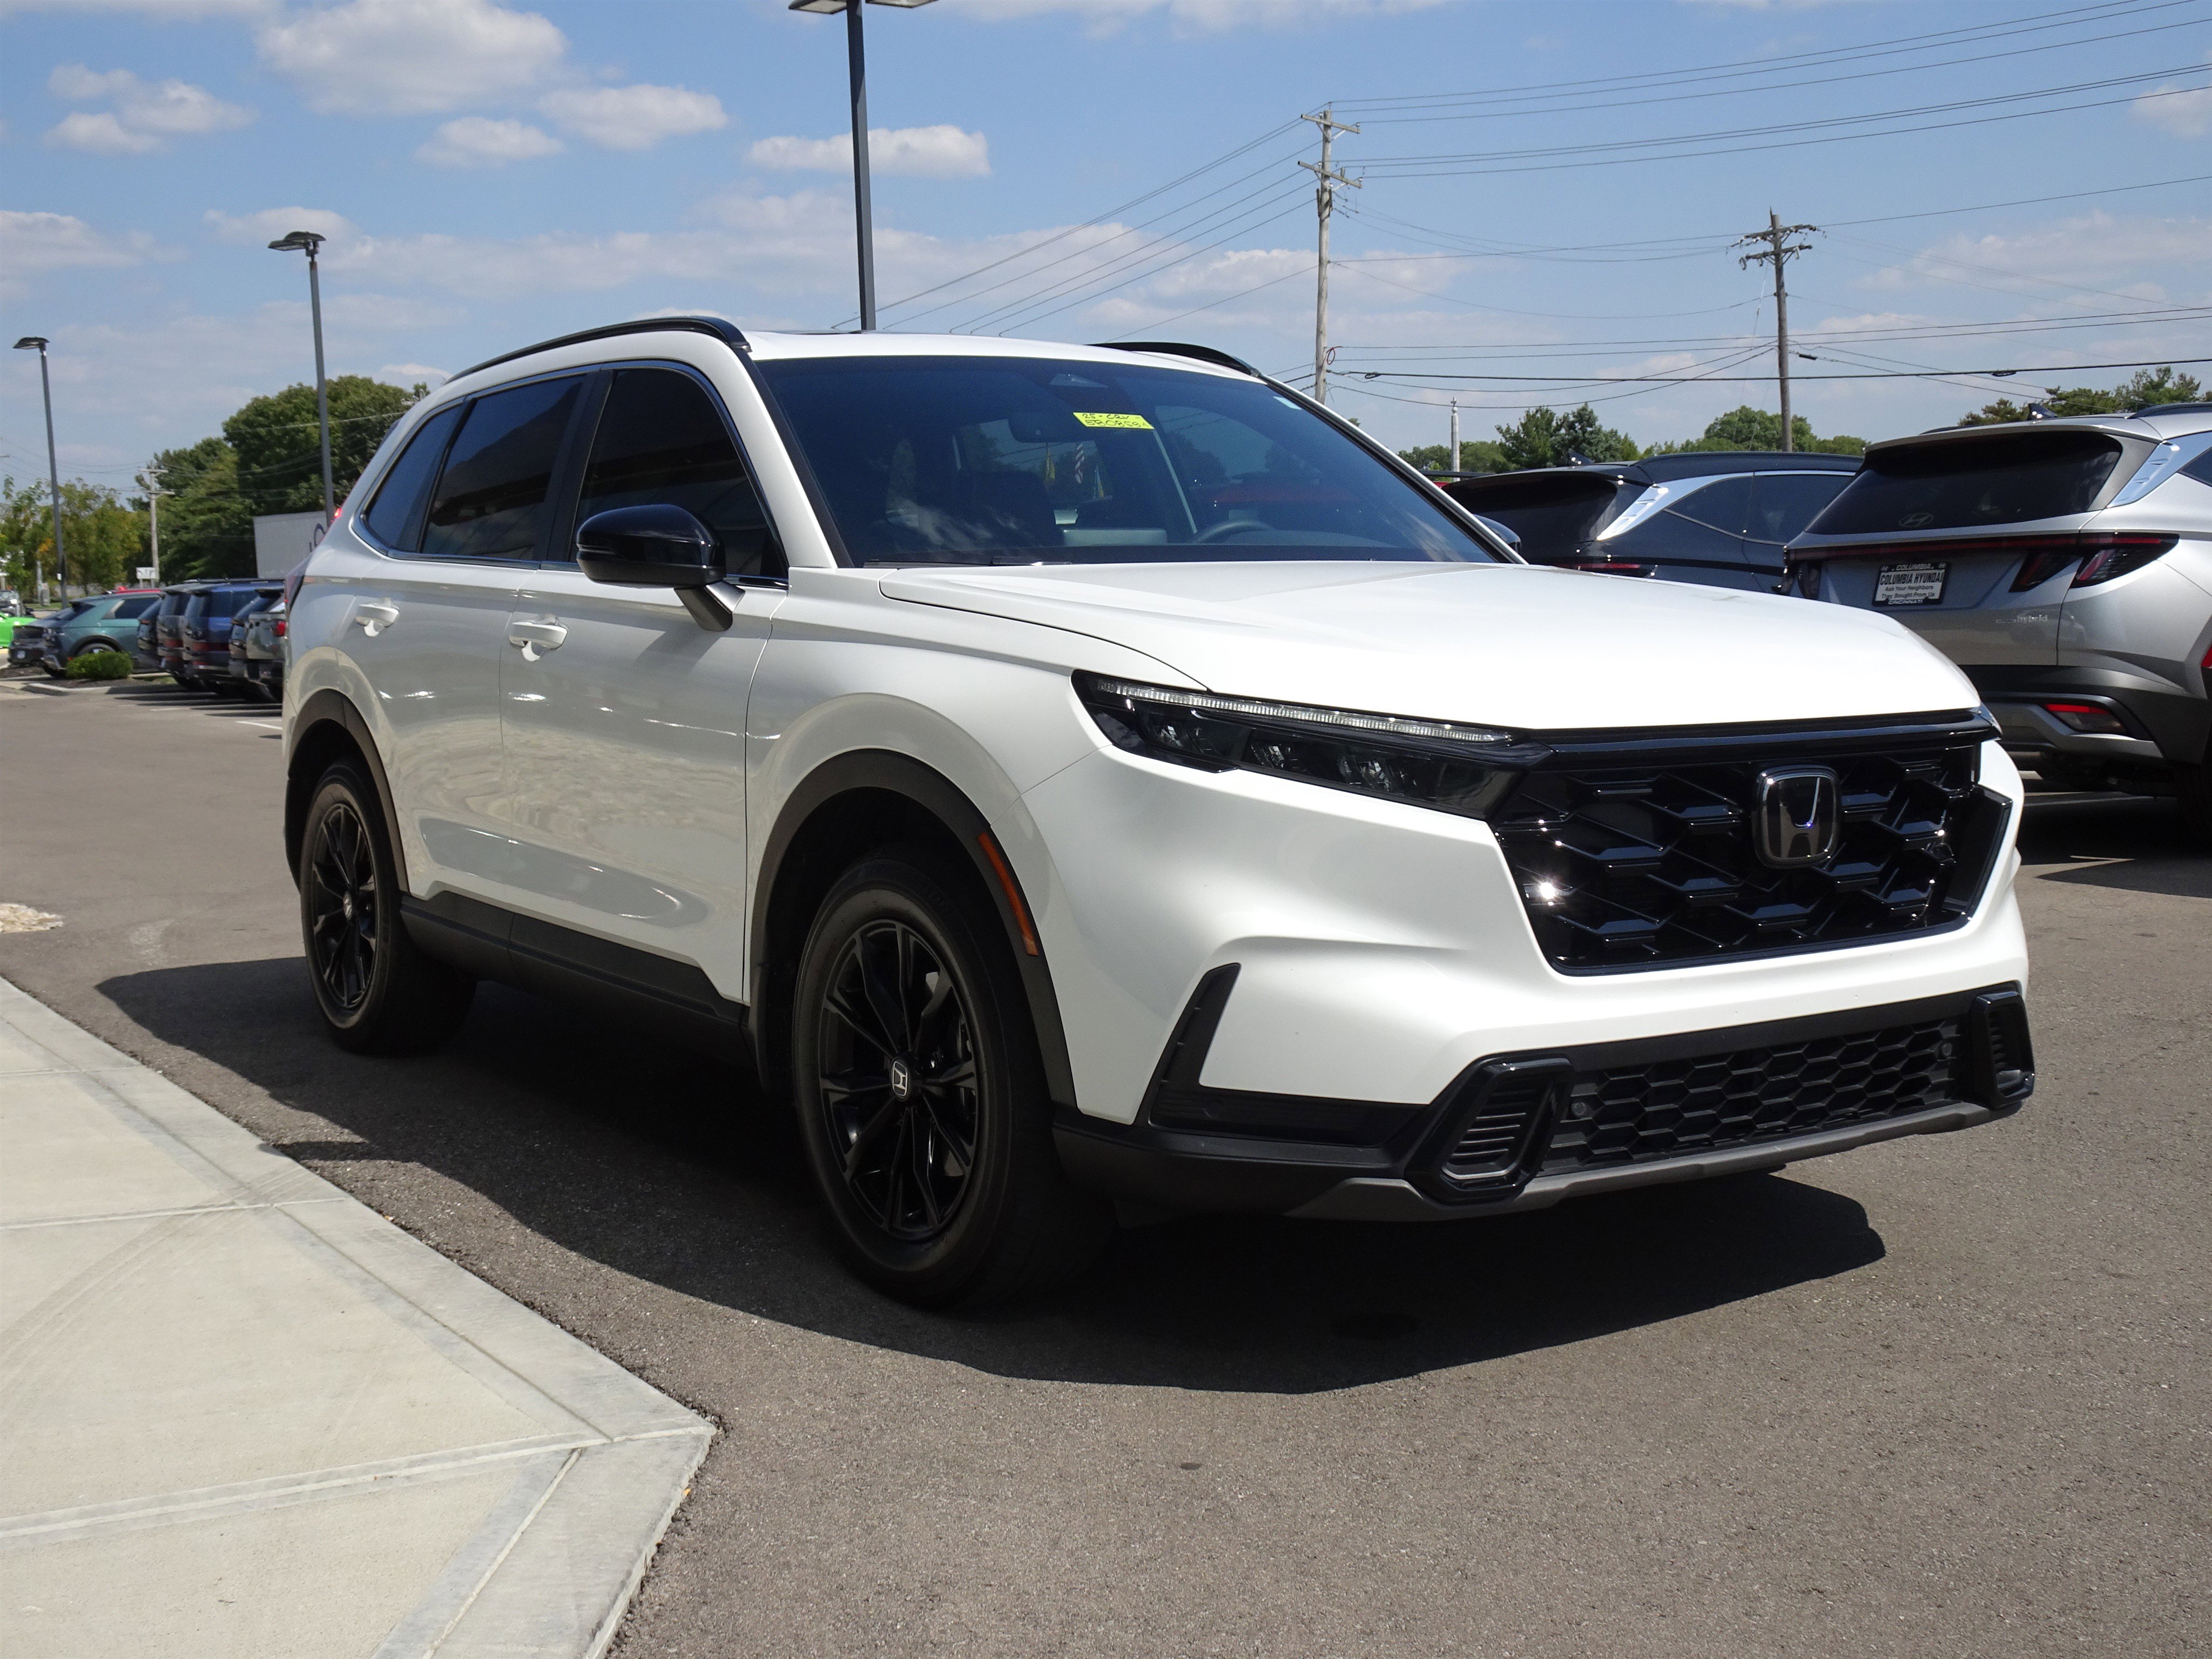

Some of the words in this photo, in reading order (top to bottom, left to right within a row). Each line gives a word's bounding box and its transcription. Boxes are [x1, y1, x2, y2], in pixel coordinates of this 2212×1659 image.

[1880, 573, 1913, 585] COLUMBIA
[1913, 572, 1944, 584] HYUNDAI
[2017, 614, 2048, 624] hybrid
